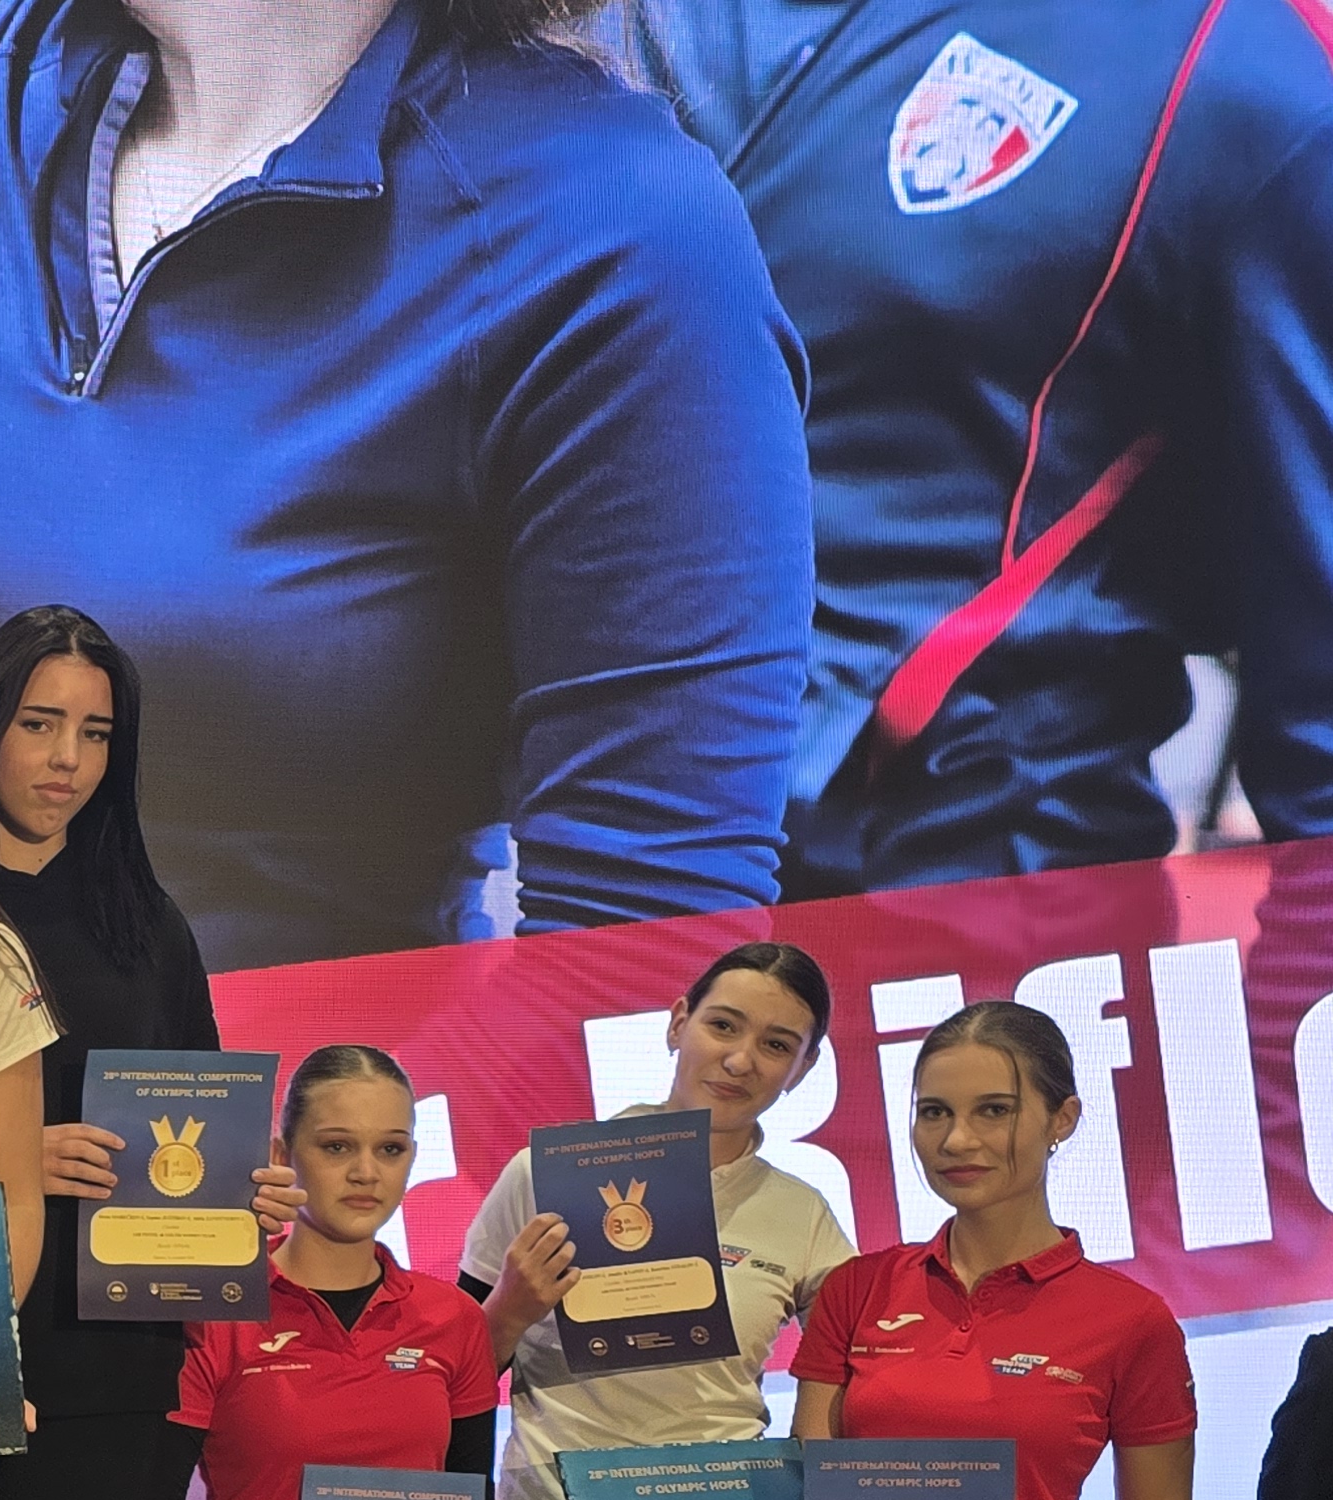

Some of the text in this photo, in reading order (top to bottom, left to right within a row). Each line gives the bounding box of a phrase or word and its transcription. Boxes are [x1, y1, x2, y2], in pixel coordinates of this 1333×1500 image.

[120, 1072, 195, 1082] INTERNATIONAL
[198, 1073, 262, 1082] COMPETITION
[136, 1088, 228, 1098] OF OLYMPIC HOPES
[561, 1137, 632, 1154] INTERNATIONAL
[635, 1130, 696, 1144] COMPETITION
[578, 1149, 664, 1167] OF OLYMPIC HOPES
[610, 1463, 702, 1479] INTERNATIONAL
[704, 1458, 784, 1472] COMPETITION
[839, 1461, 922, 1471] INTERNATIONAL
[925, 1462, 1000, 1471] COMPETITION
[636, 1479, 749, 1495] OF OLYMPIC HOPES
[858, 1478, 961, 1487] OF OLYMPIC HOPES
[334, 1488, 405, 1500] INTERNATIONAL
